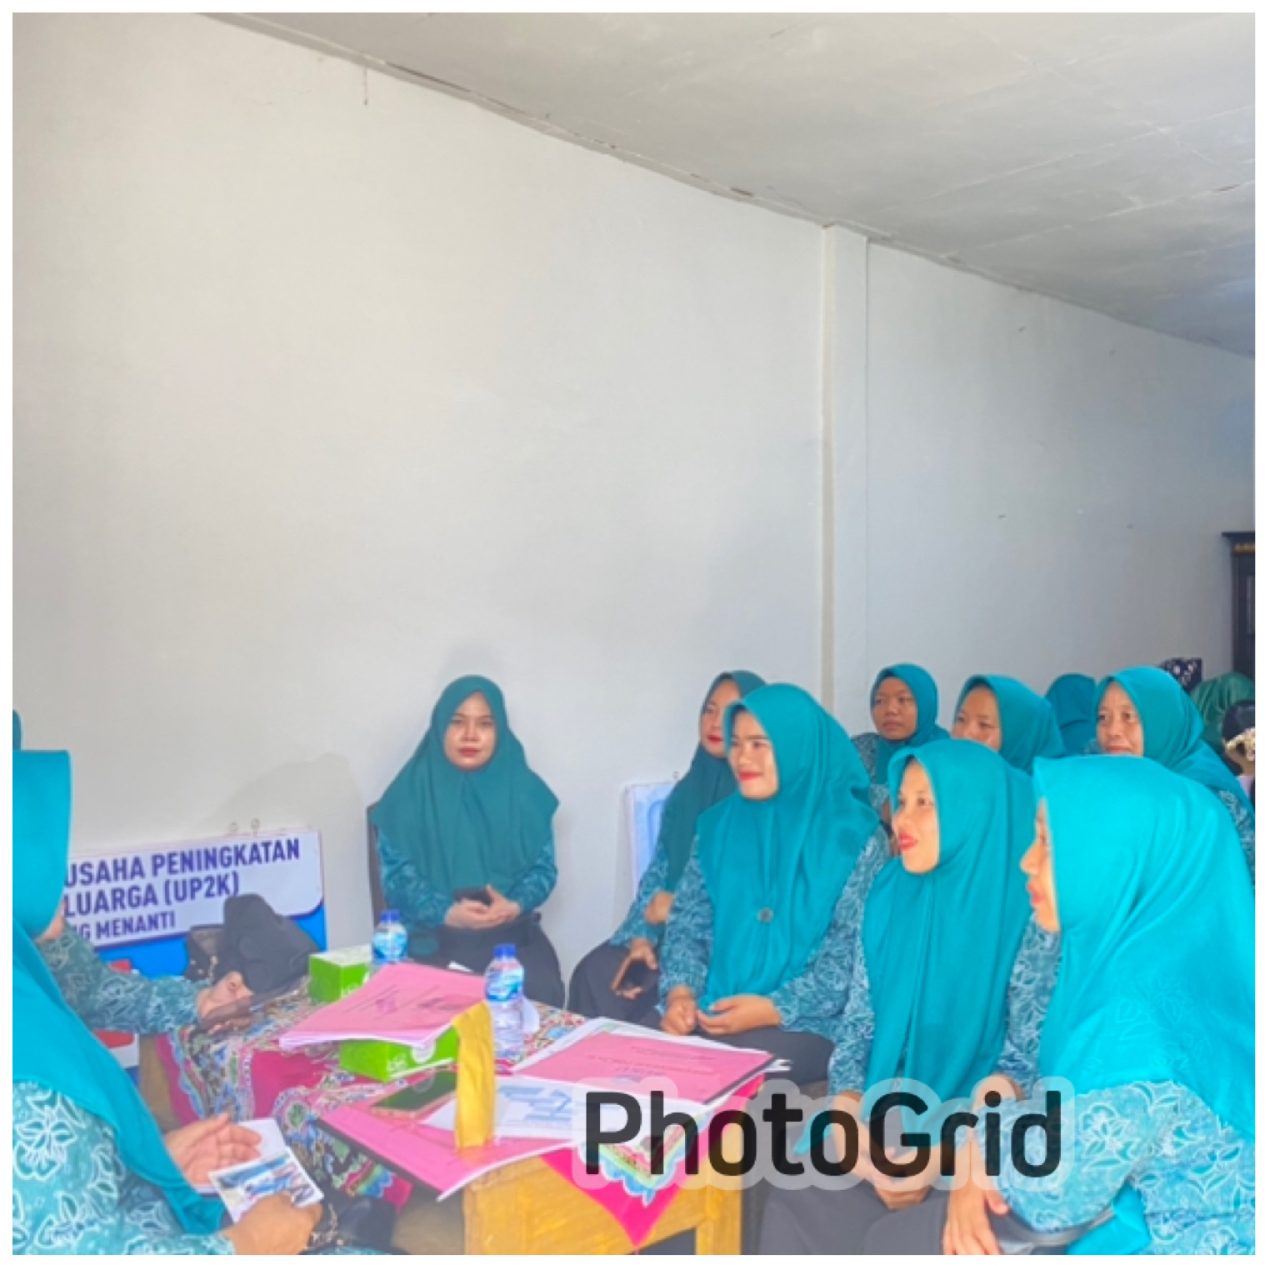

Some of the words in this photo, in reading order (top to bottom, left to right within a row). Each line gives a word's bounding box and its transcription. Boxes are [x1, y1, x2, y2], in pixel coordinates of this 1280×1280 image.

[64, 856, 146, 888] USAHA
[151, 837, 301, 877] PENINGKATAN
[164, 871, 240, 906] (UP2K)
[96, 910, 176, 940] MENANTI
